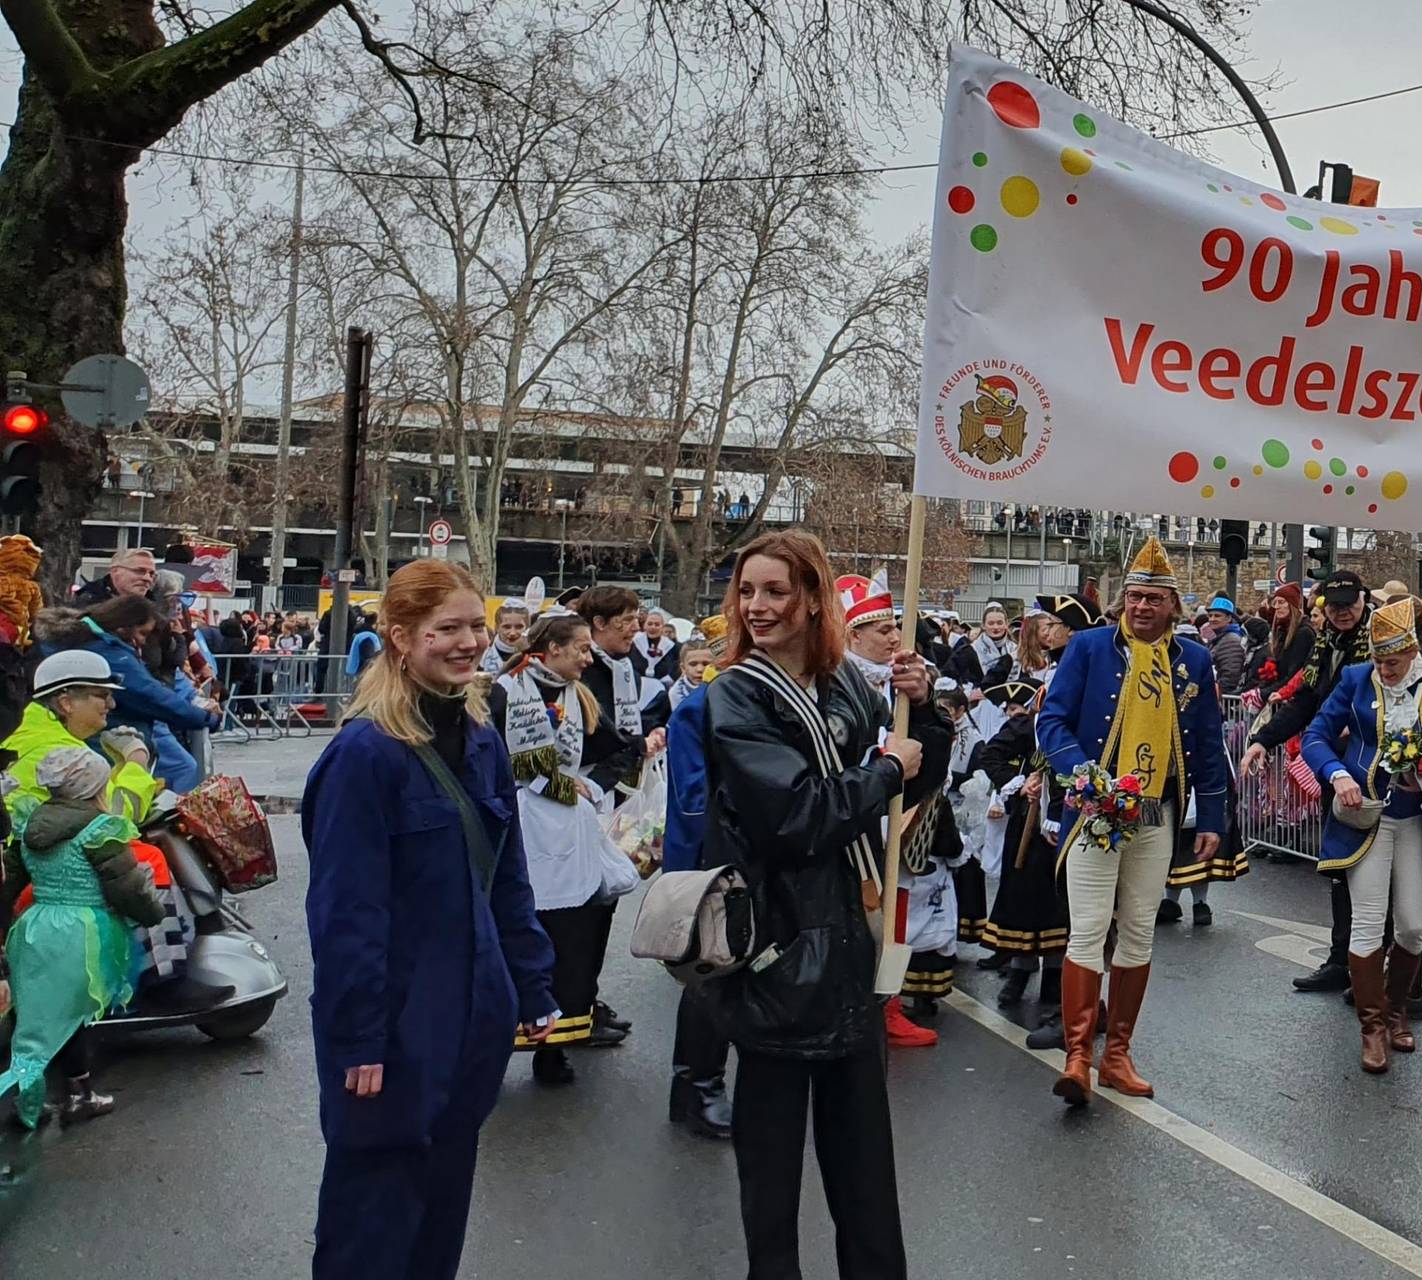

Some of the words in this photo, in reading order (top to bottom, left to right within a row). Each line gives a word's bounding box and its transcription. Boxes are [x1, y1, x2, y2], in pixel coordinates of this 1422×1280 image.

[1200, 227, 1295, 303] 90
[939, 361, 980, 400] FREUNDE
[983, 359, 1007, 369] UND
[1009, 363, 1051, 410] FÖRDERER
[935, 415, 946, 435] DES
[939, 435, 987, 480] KÖLNISCHEN
[988, 444, 1047, 481] BRAUCHTUMS
